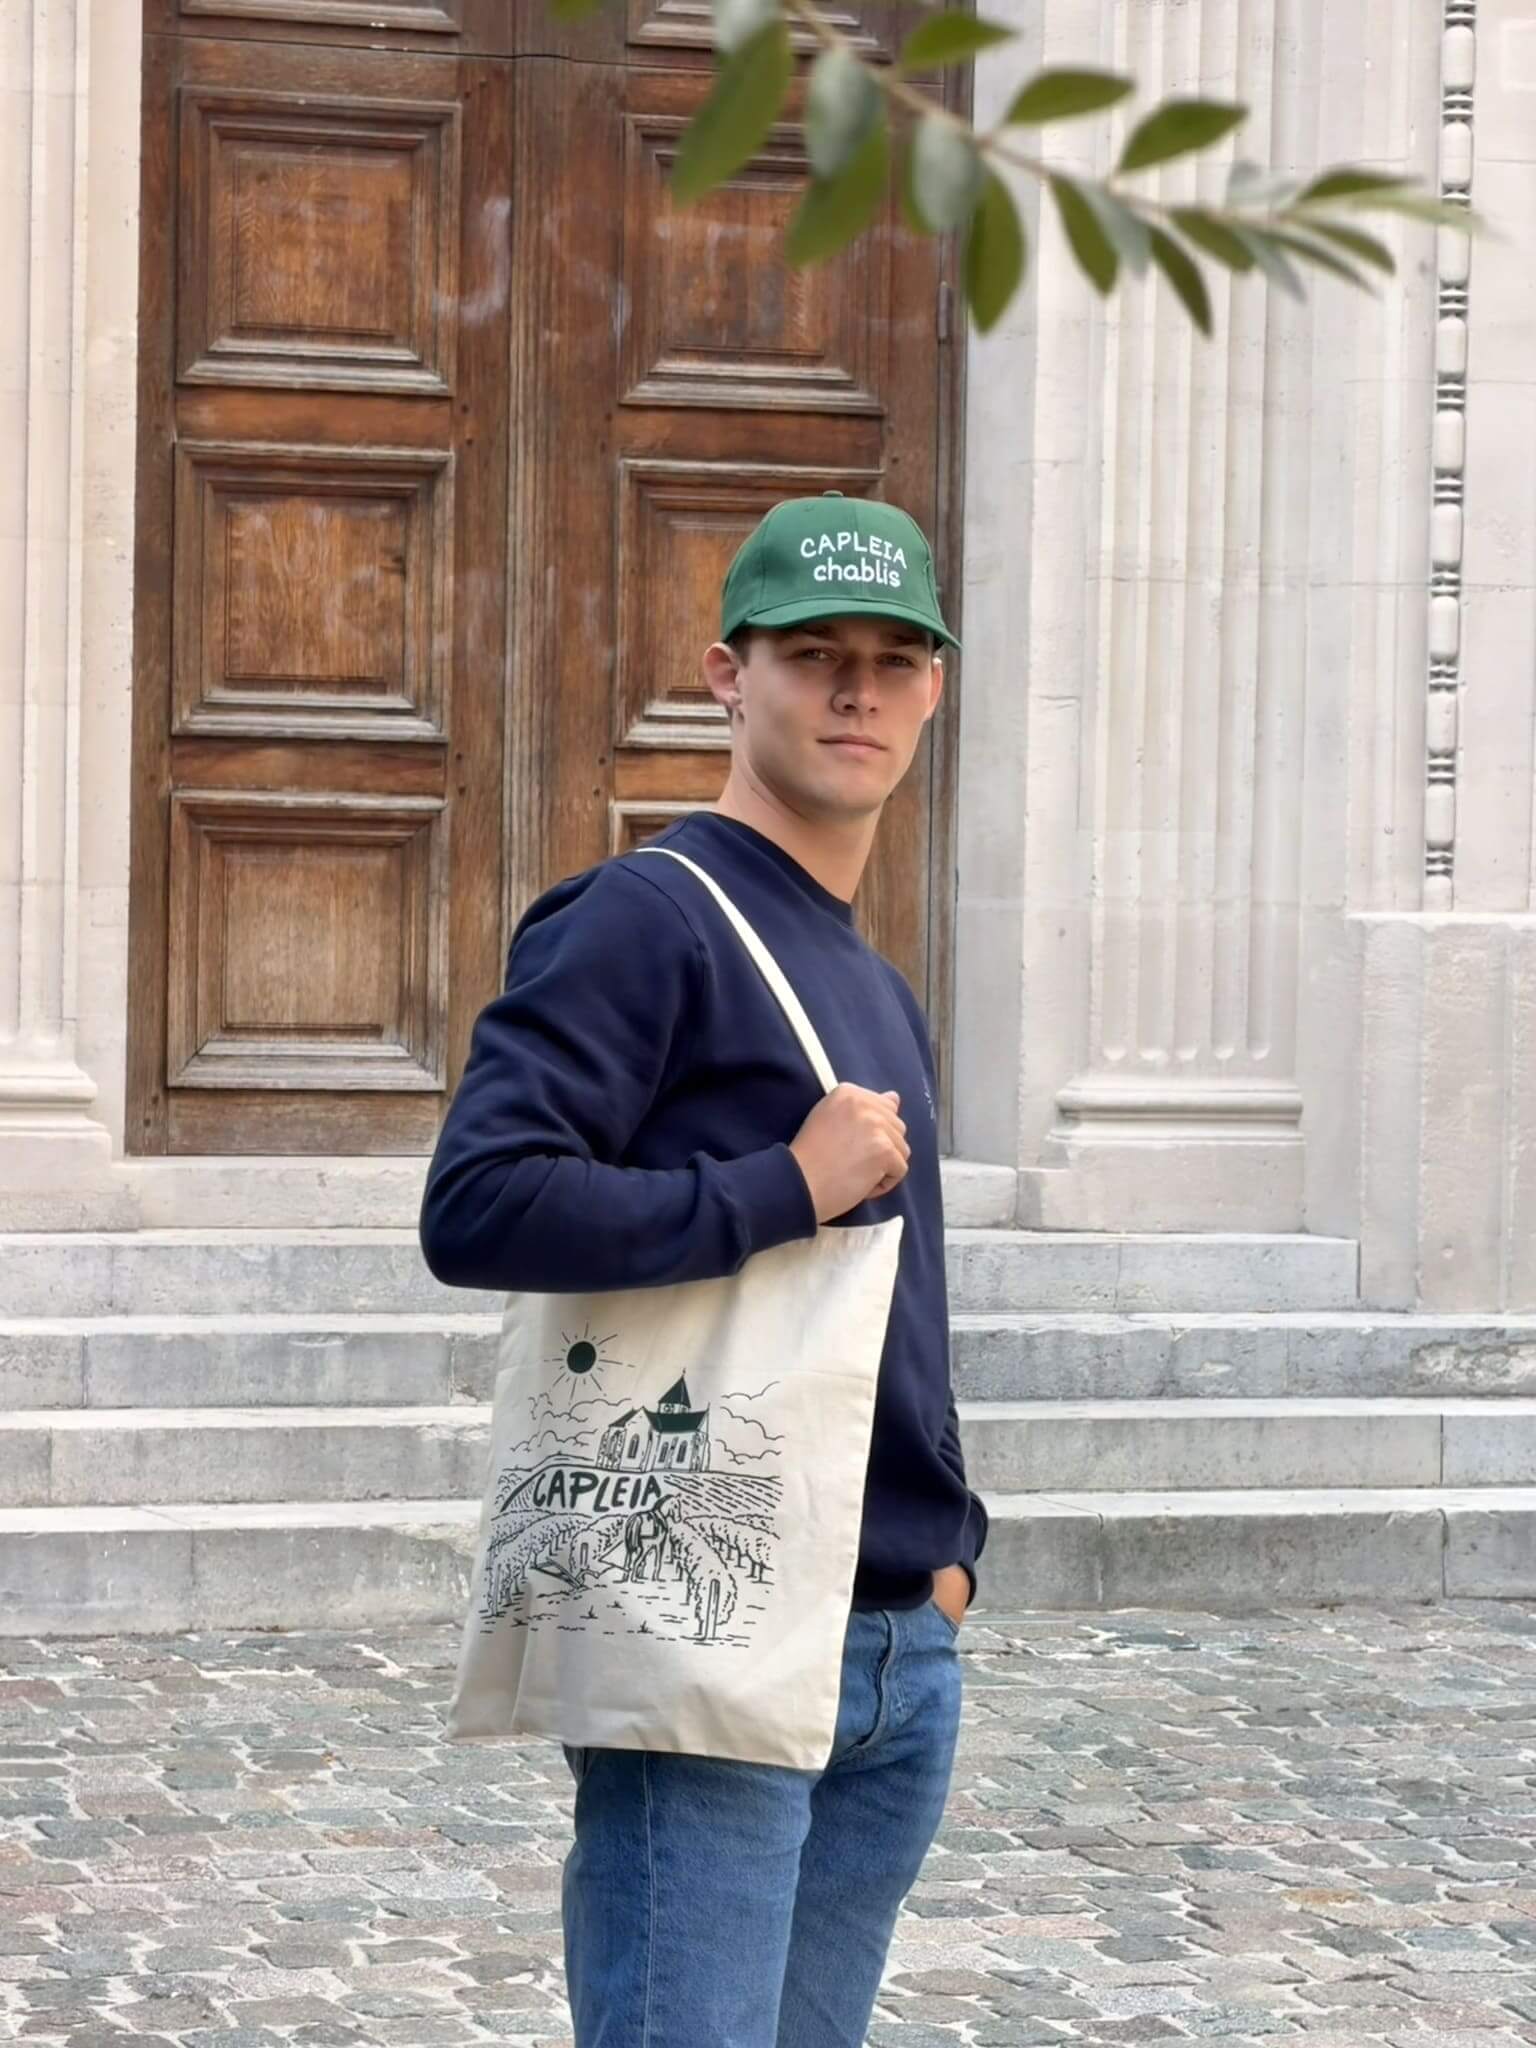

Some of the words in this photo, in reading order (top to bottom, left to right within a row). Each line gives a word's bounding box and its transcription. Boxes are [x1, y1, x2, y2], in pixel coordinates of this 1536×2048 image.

[800, 531, 907, 569] CAPLEIA
[813, 556, 900, 588] chablis
[533, 1469, 661, 1513] CAPLEIA
